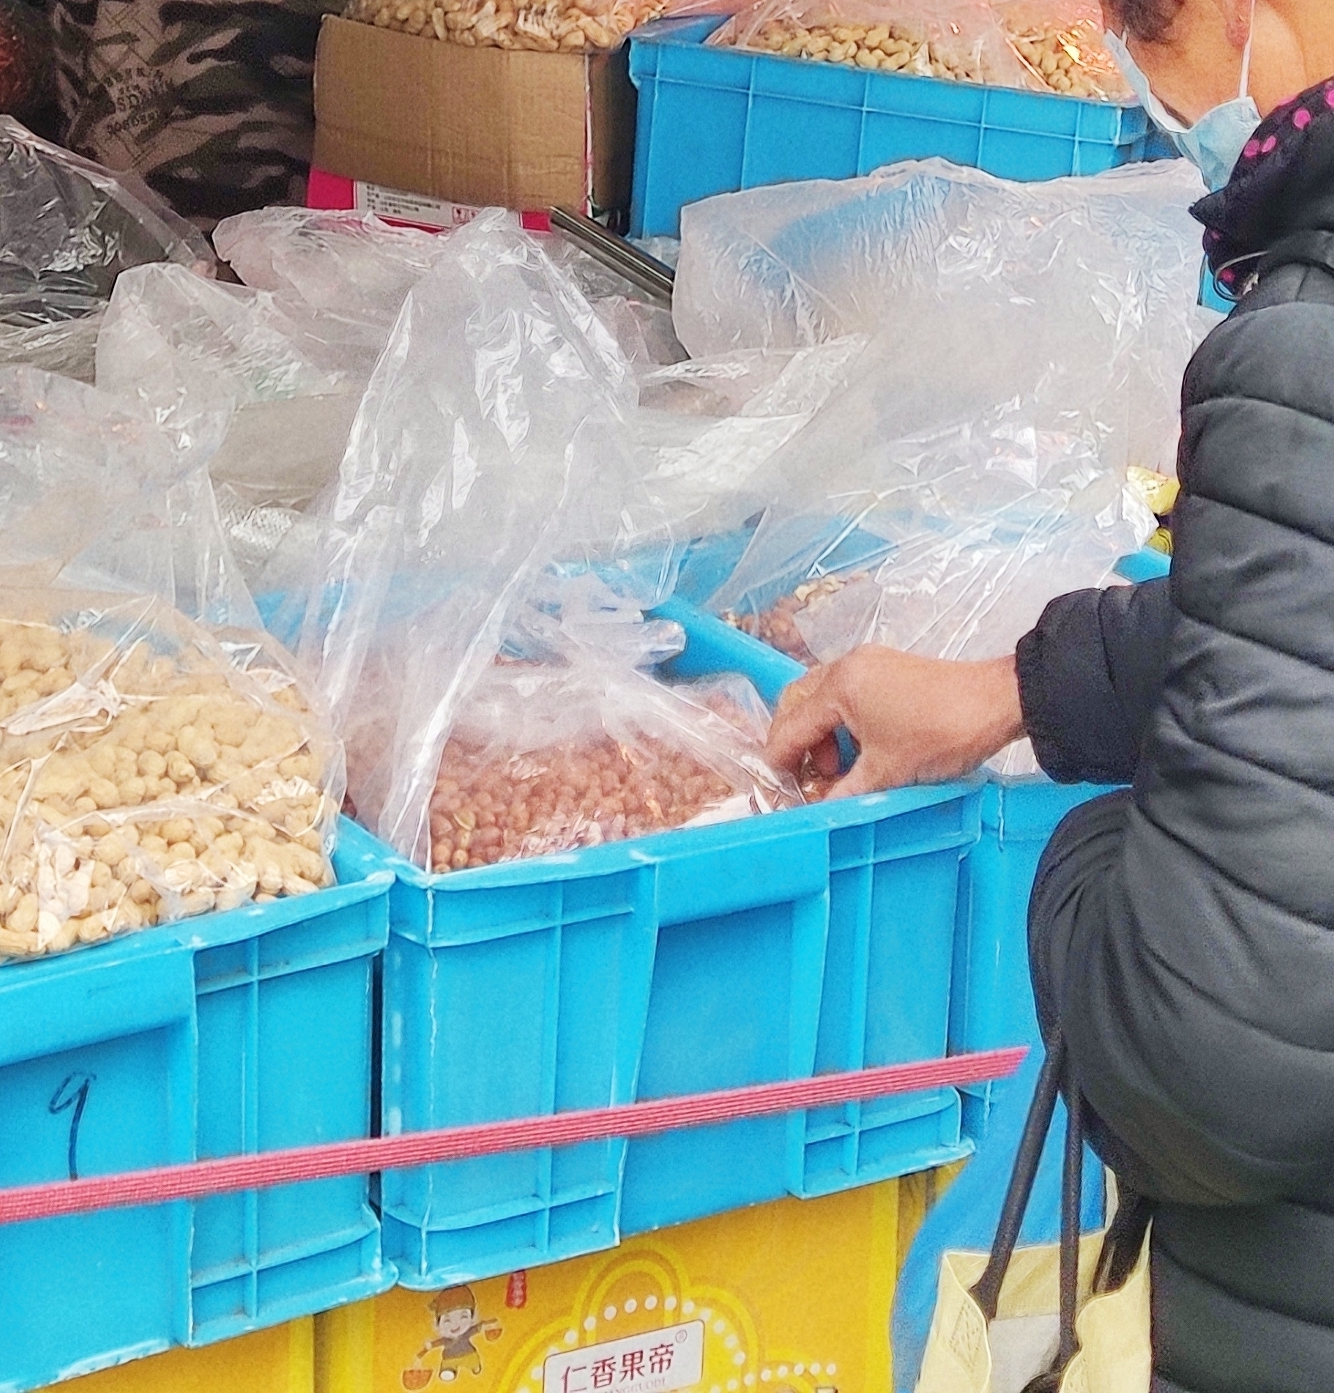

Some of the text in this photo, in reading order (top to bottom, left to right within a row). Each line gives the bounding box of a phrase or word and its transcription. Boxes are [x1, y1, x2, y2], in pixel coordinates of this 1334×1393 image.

[48, 1071, 97, 1180] 9
[561, 1342, 675, 1393] 仁香果帝
